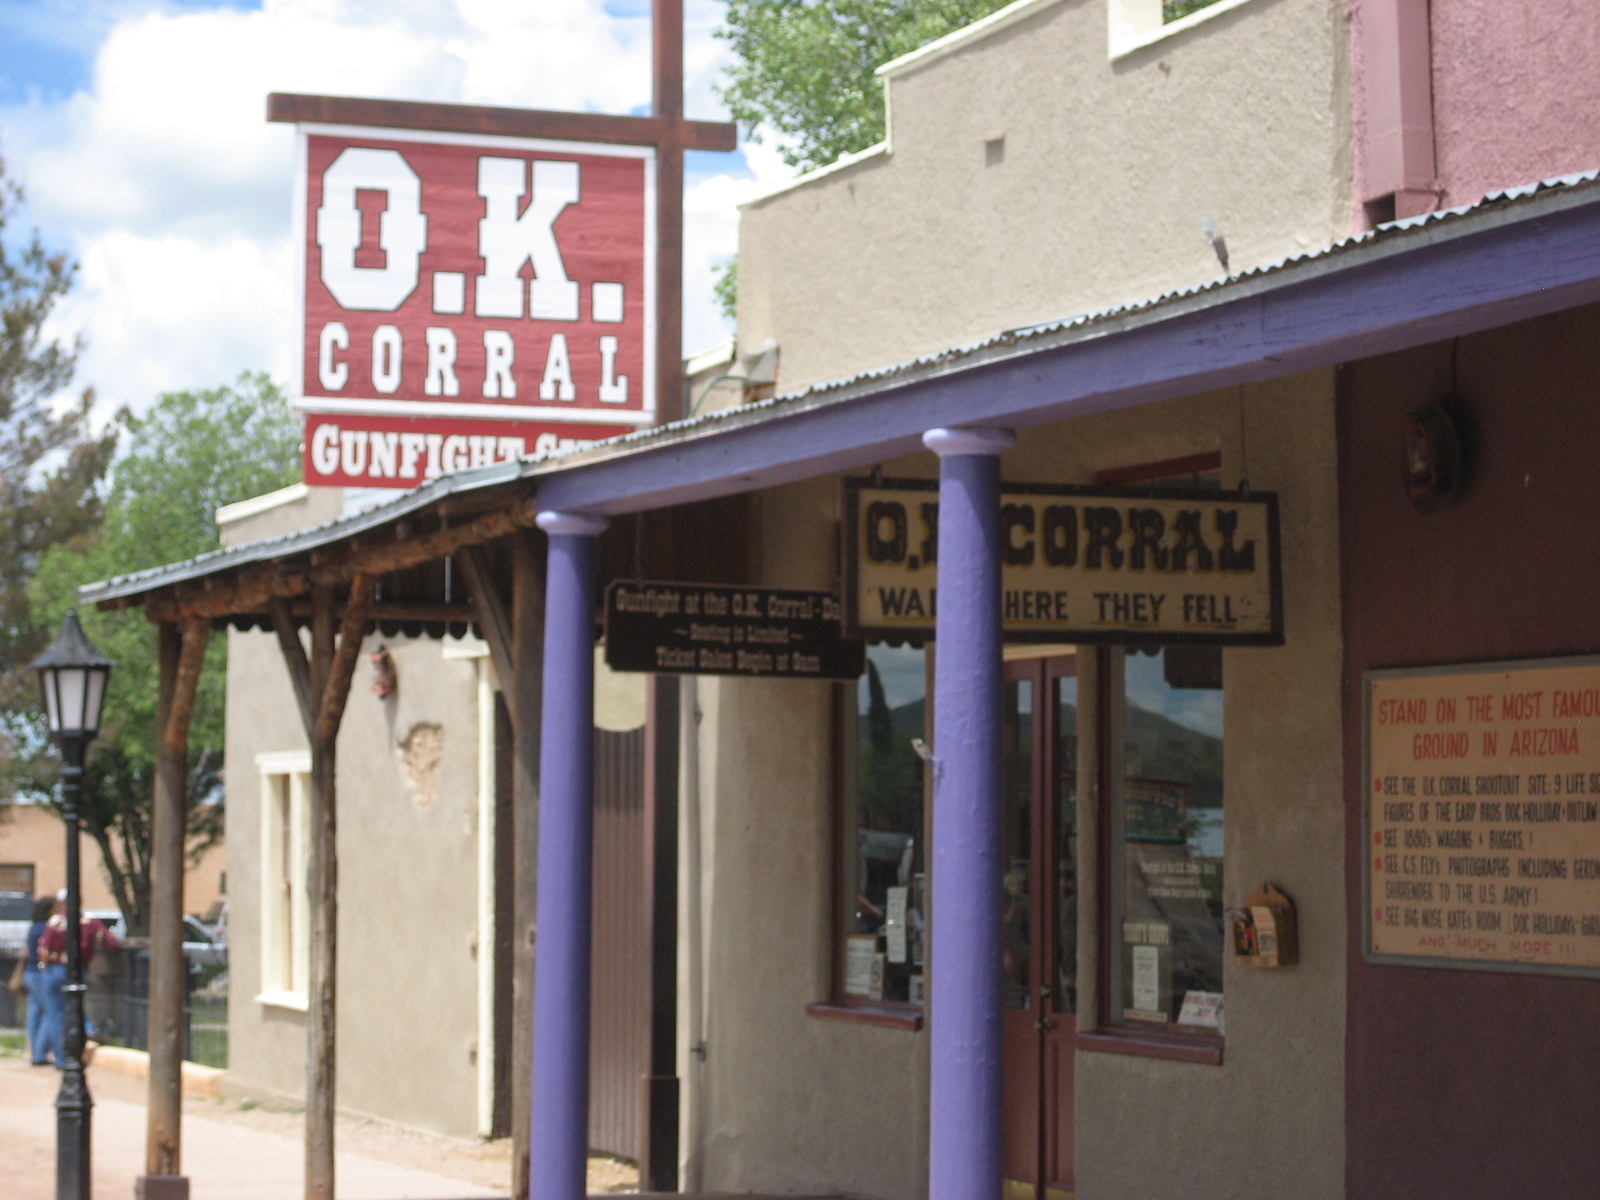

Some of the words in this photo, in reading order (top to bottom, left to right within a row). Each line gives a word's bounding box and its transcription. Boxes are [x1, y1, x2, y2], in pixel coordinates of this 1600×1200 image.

[316, 146, 625, 322] O.K.
[318, 321, 628, 403] CORRAL
[310, 423, 526, 480] GUNFIGHT
[1002, 502, 1256, 572] CORRAL
[1004, 589, 1068, 620] HERE
[1093, 592, 1167, 622] THEY
[1182, 594, 1239, 623] FELL
[1378, 697, 1428, 725] STAND
[1436, 697, 1457, 724] ON
[1466, 694, 1493, 723] THE
[1502, 691, 1543, 720] MOST
[1413, 731, 1469, 760] GROUND
[1483, 730, 1497, 757] IN
[1510, 727, 1580, 757] ARIZONA
[1384, 775, 1398, 795] SEE
[1402, 775, 1416, 795] THE
[1439, 774, 1472, 796] CORRAL
[1476, 773, 1520, 795] SHOOTOUT
[1554, 773, 1561, 794] 9
[1566, 772, 1585, 794] LIFE
[1419, 801, 1429, 822] OF
[1435, 801, 1451, 822] THE
[1384, 828, 1397, 848] SEE
[1436, 830, 1473, 850] WAGONS
[1385, 853, 1398, 873] SEE
[1448, 856, 1509, 877] PHOTOGRAPHS
[1518, 858, 1567, 879] INCLUDING
[1386, 880, 1433, 902] SURRENDER
[1439, 882, 1450, 903] TO
[1456, 884, 1473, 904] THE
[1502, 885, 1531, 907] ARMY
[1385, 905, 1399, 926] SEE
[1476, 910, 1500, 931] ROOM
[1418, 936, 1445, 948] AND
[1457, 938, 1496, 953] MUCH
[1509, 940, 1551, 955] MORE
